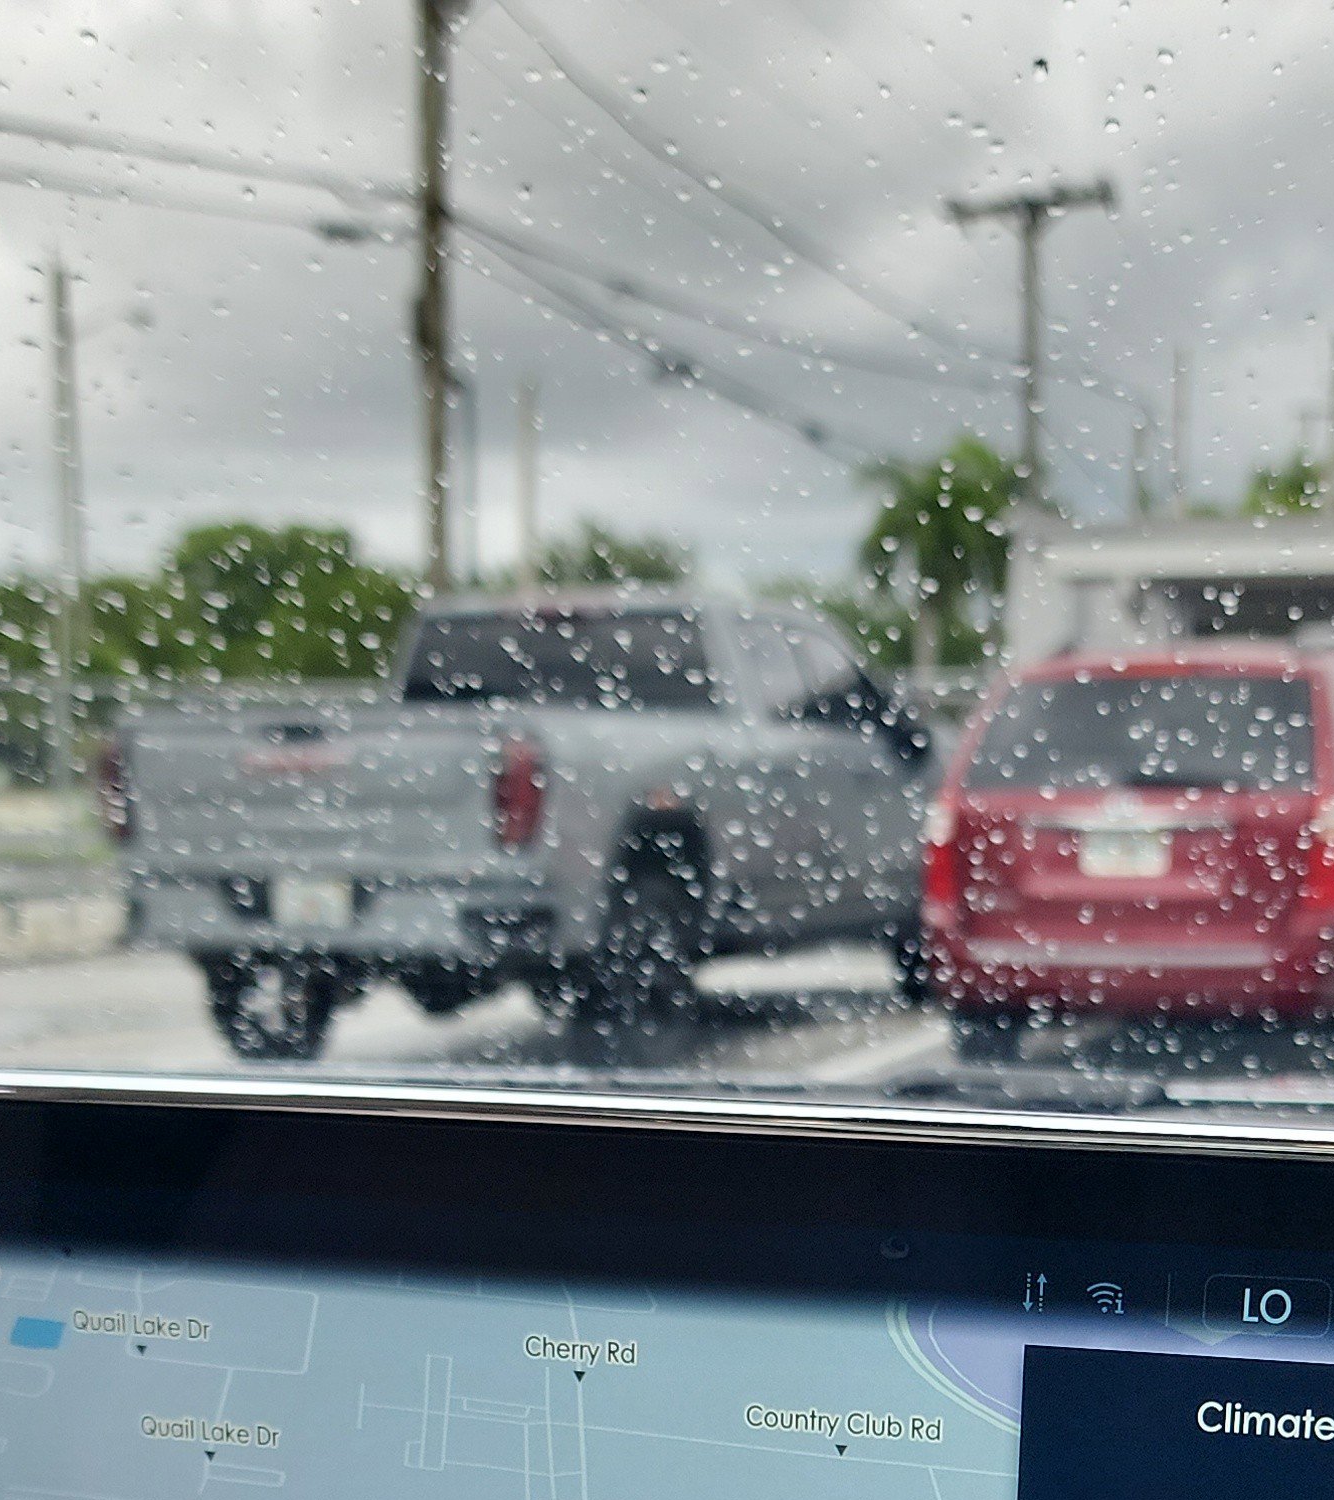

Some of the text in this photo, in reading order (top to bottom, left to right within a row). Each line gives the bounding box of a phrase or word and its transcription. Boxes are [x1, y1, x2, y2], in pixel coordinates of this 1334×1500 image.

[1242, 1287, 1292, 1324] LO
[72, 1310, 210, 1341] Quail Lake Dr
[525, 1336, 636, 1366] Cherry Rd
[141, 1416, 280, 1448] Quail Lake Dr
[746, 1405, 941, 1441] Country Club Rd
